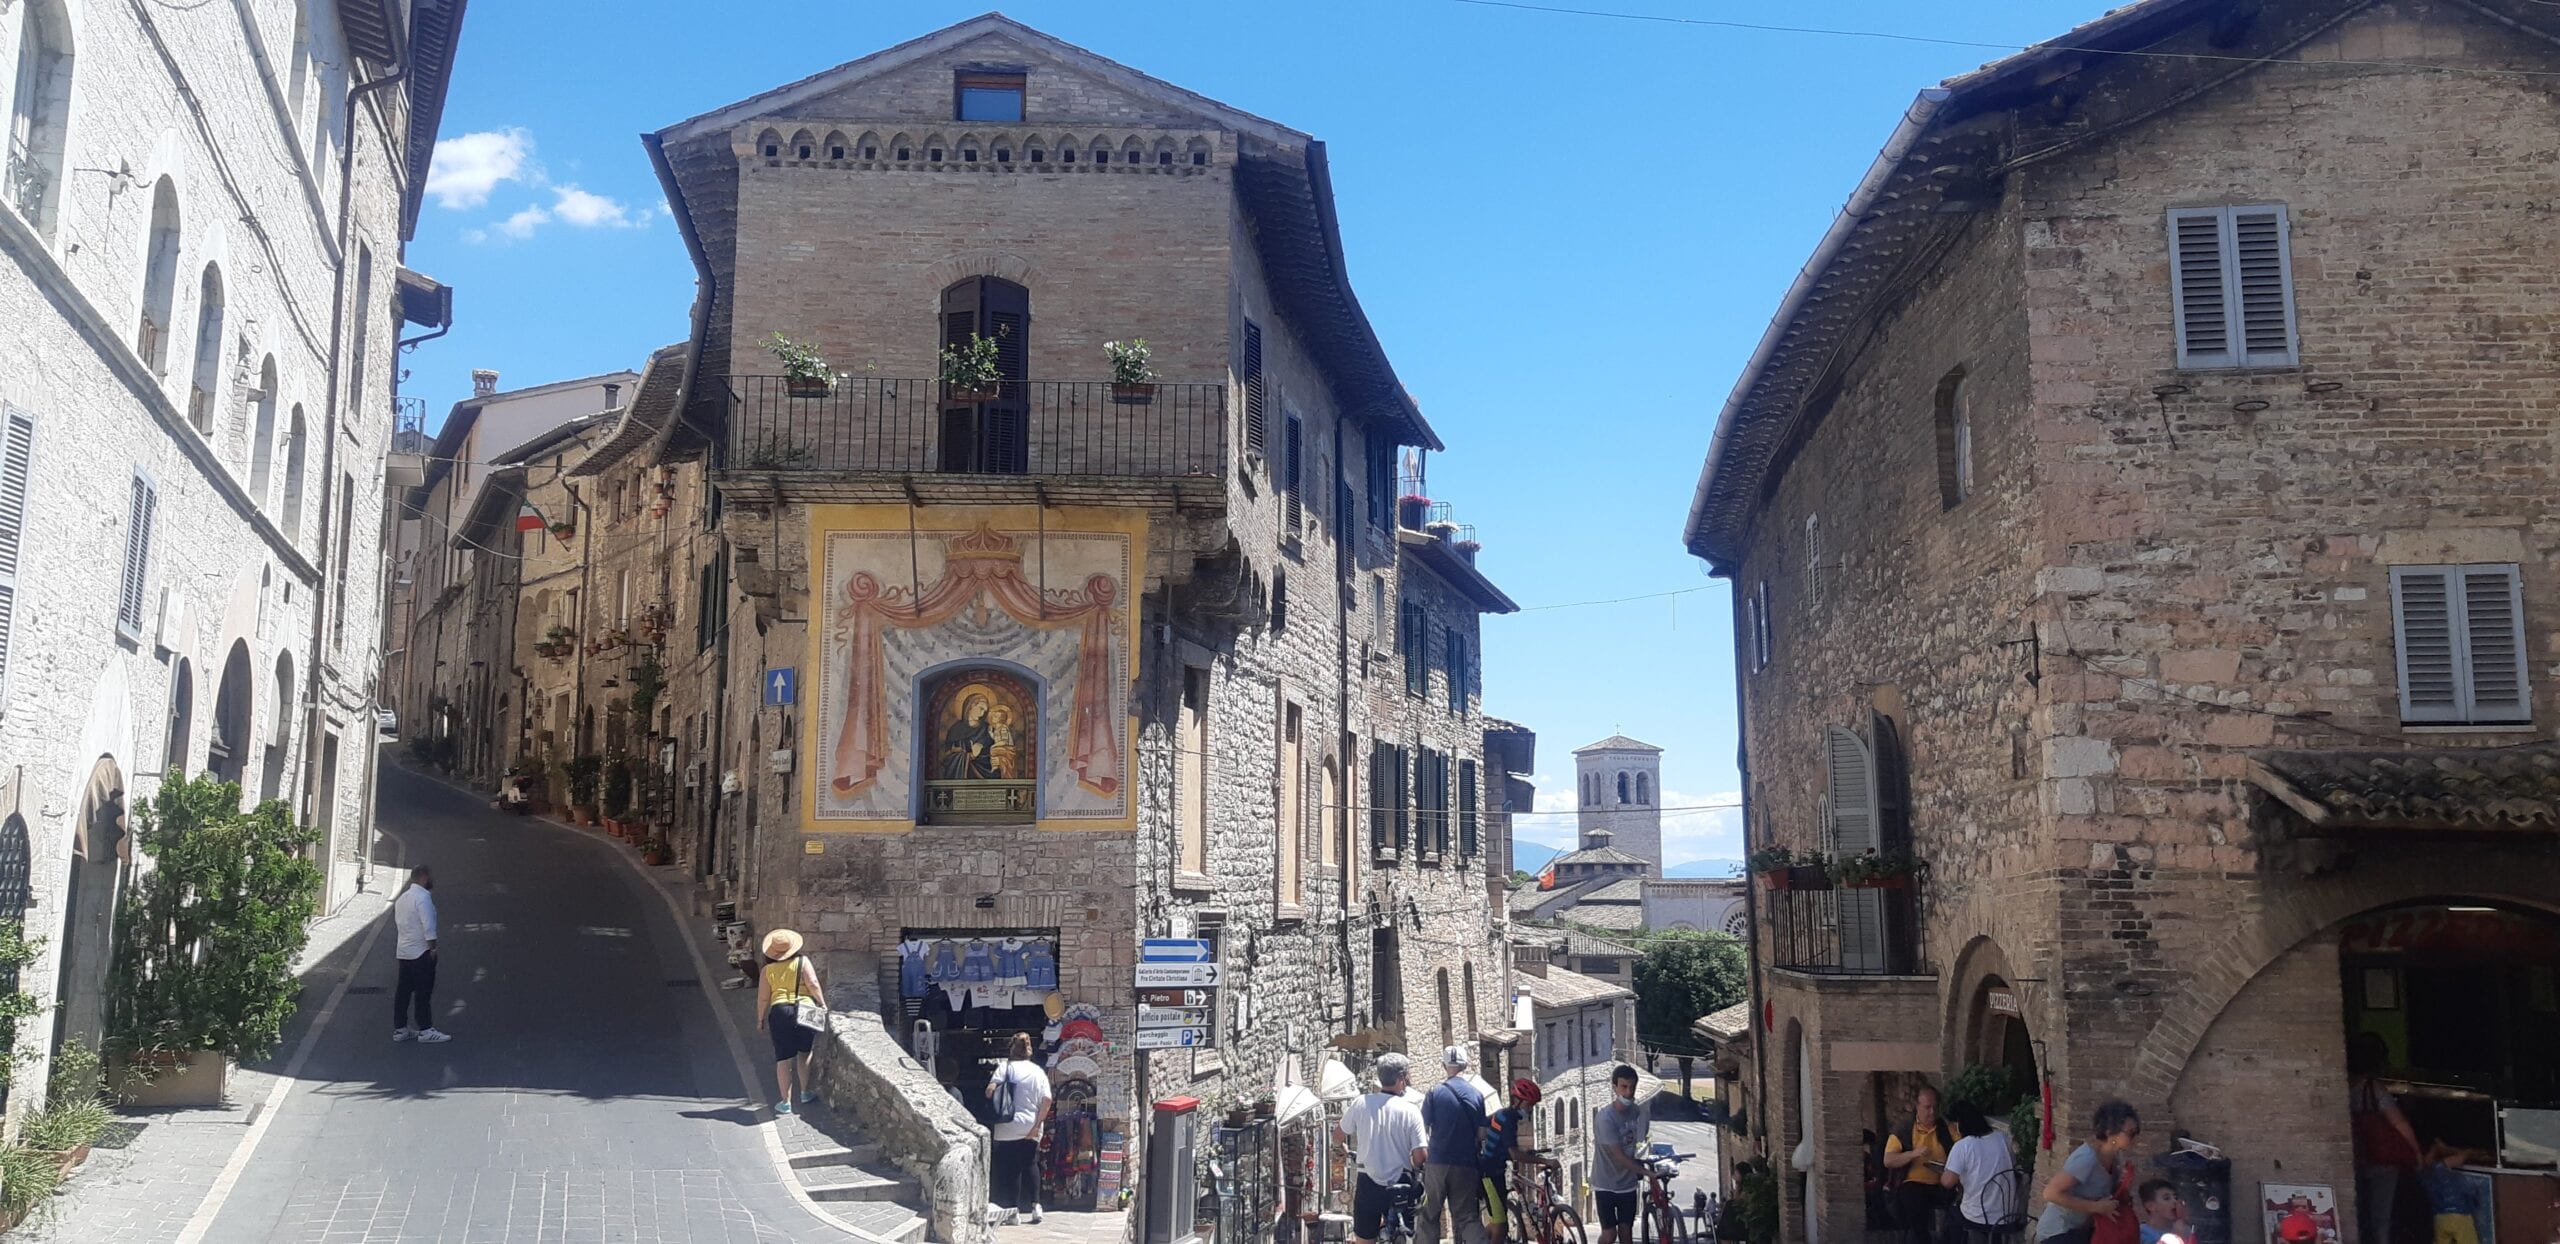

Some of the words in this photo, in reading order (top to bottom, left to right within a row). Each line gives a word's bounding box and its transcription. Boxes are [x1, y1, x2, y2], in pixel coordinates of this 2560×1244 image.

[1150, 994, 1170, 1002] Pietro
[1989, 992, 2018, 1012] PIZZERIA
[1141, 1012, 1159, 1022] ufficio
[1160, 1012, 1181, 1023] postale
[1139, 1031, 1169, 1039] parcheggio
[1325, 1102, 1343, 1115] BAR
